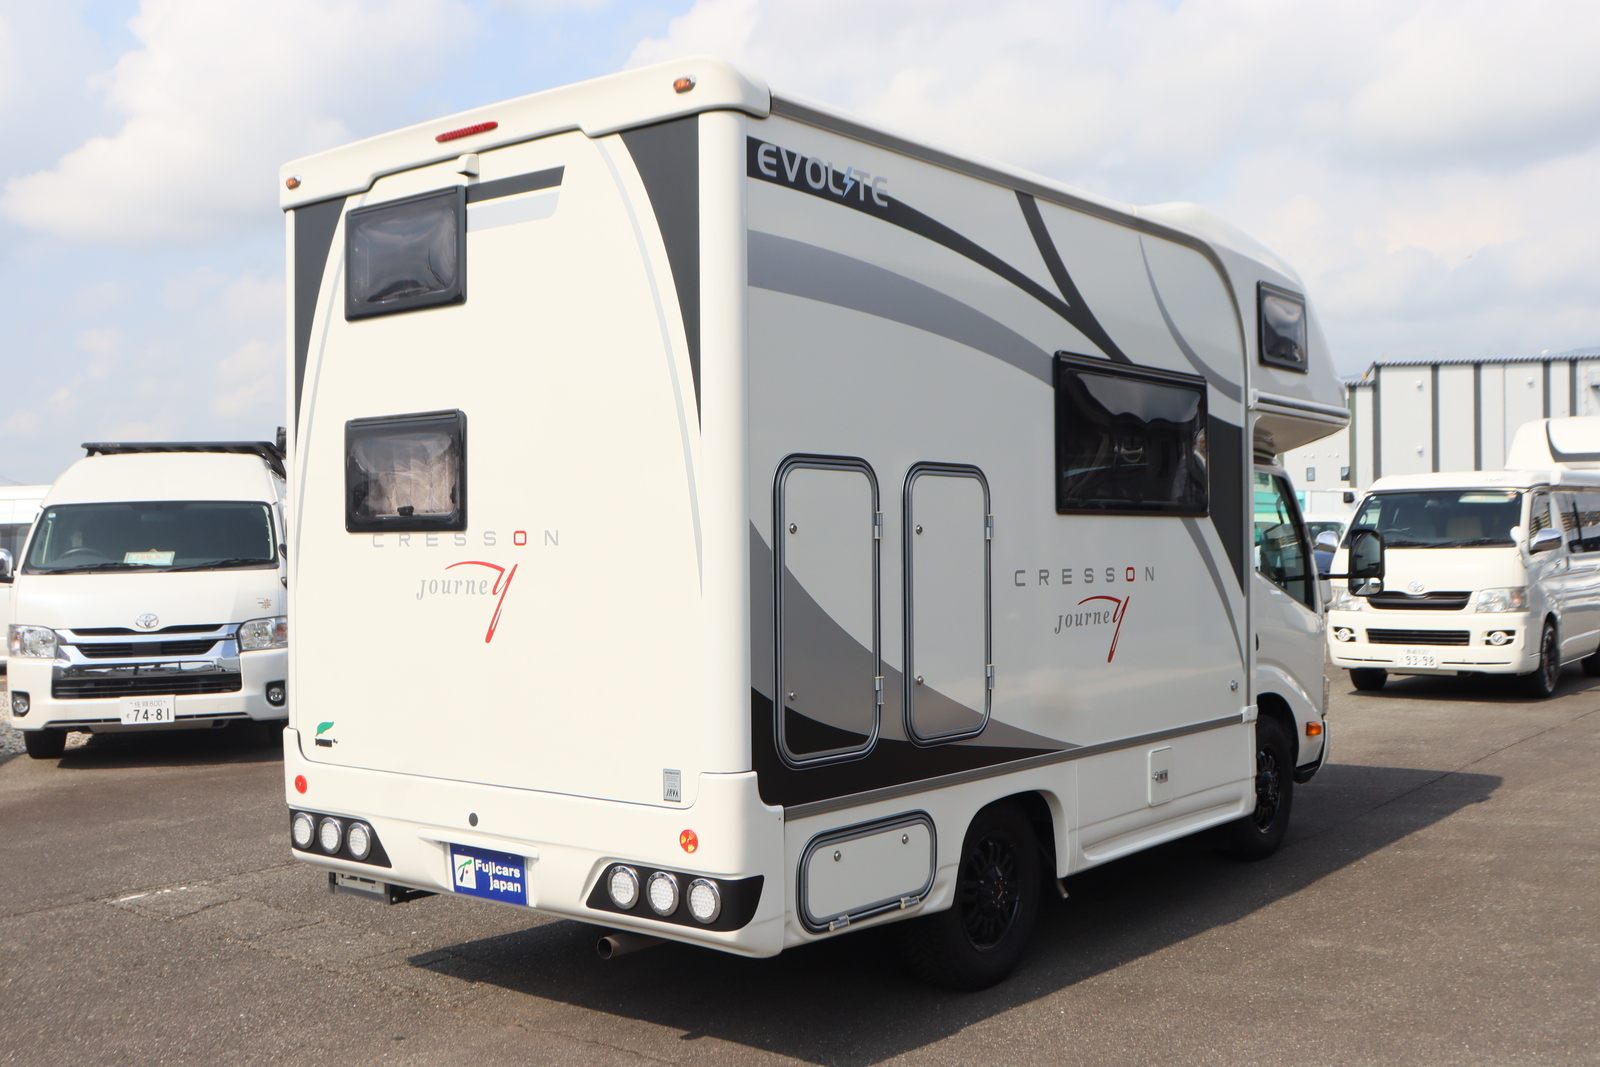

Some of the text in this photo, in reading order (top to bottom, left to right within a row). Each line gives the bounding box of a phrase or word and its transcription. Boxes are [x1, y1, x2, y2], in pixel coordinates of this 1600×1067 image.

[372, 530, 559, 547] CRESSON
[1014, 566, 1155, 587] CRESSON
[133, 708, 170, 722] 74-81
[475, 858, 521, 878] Fujicars
